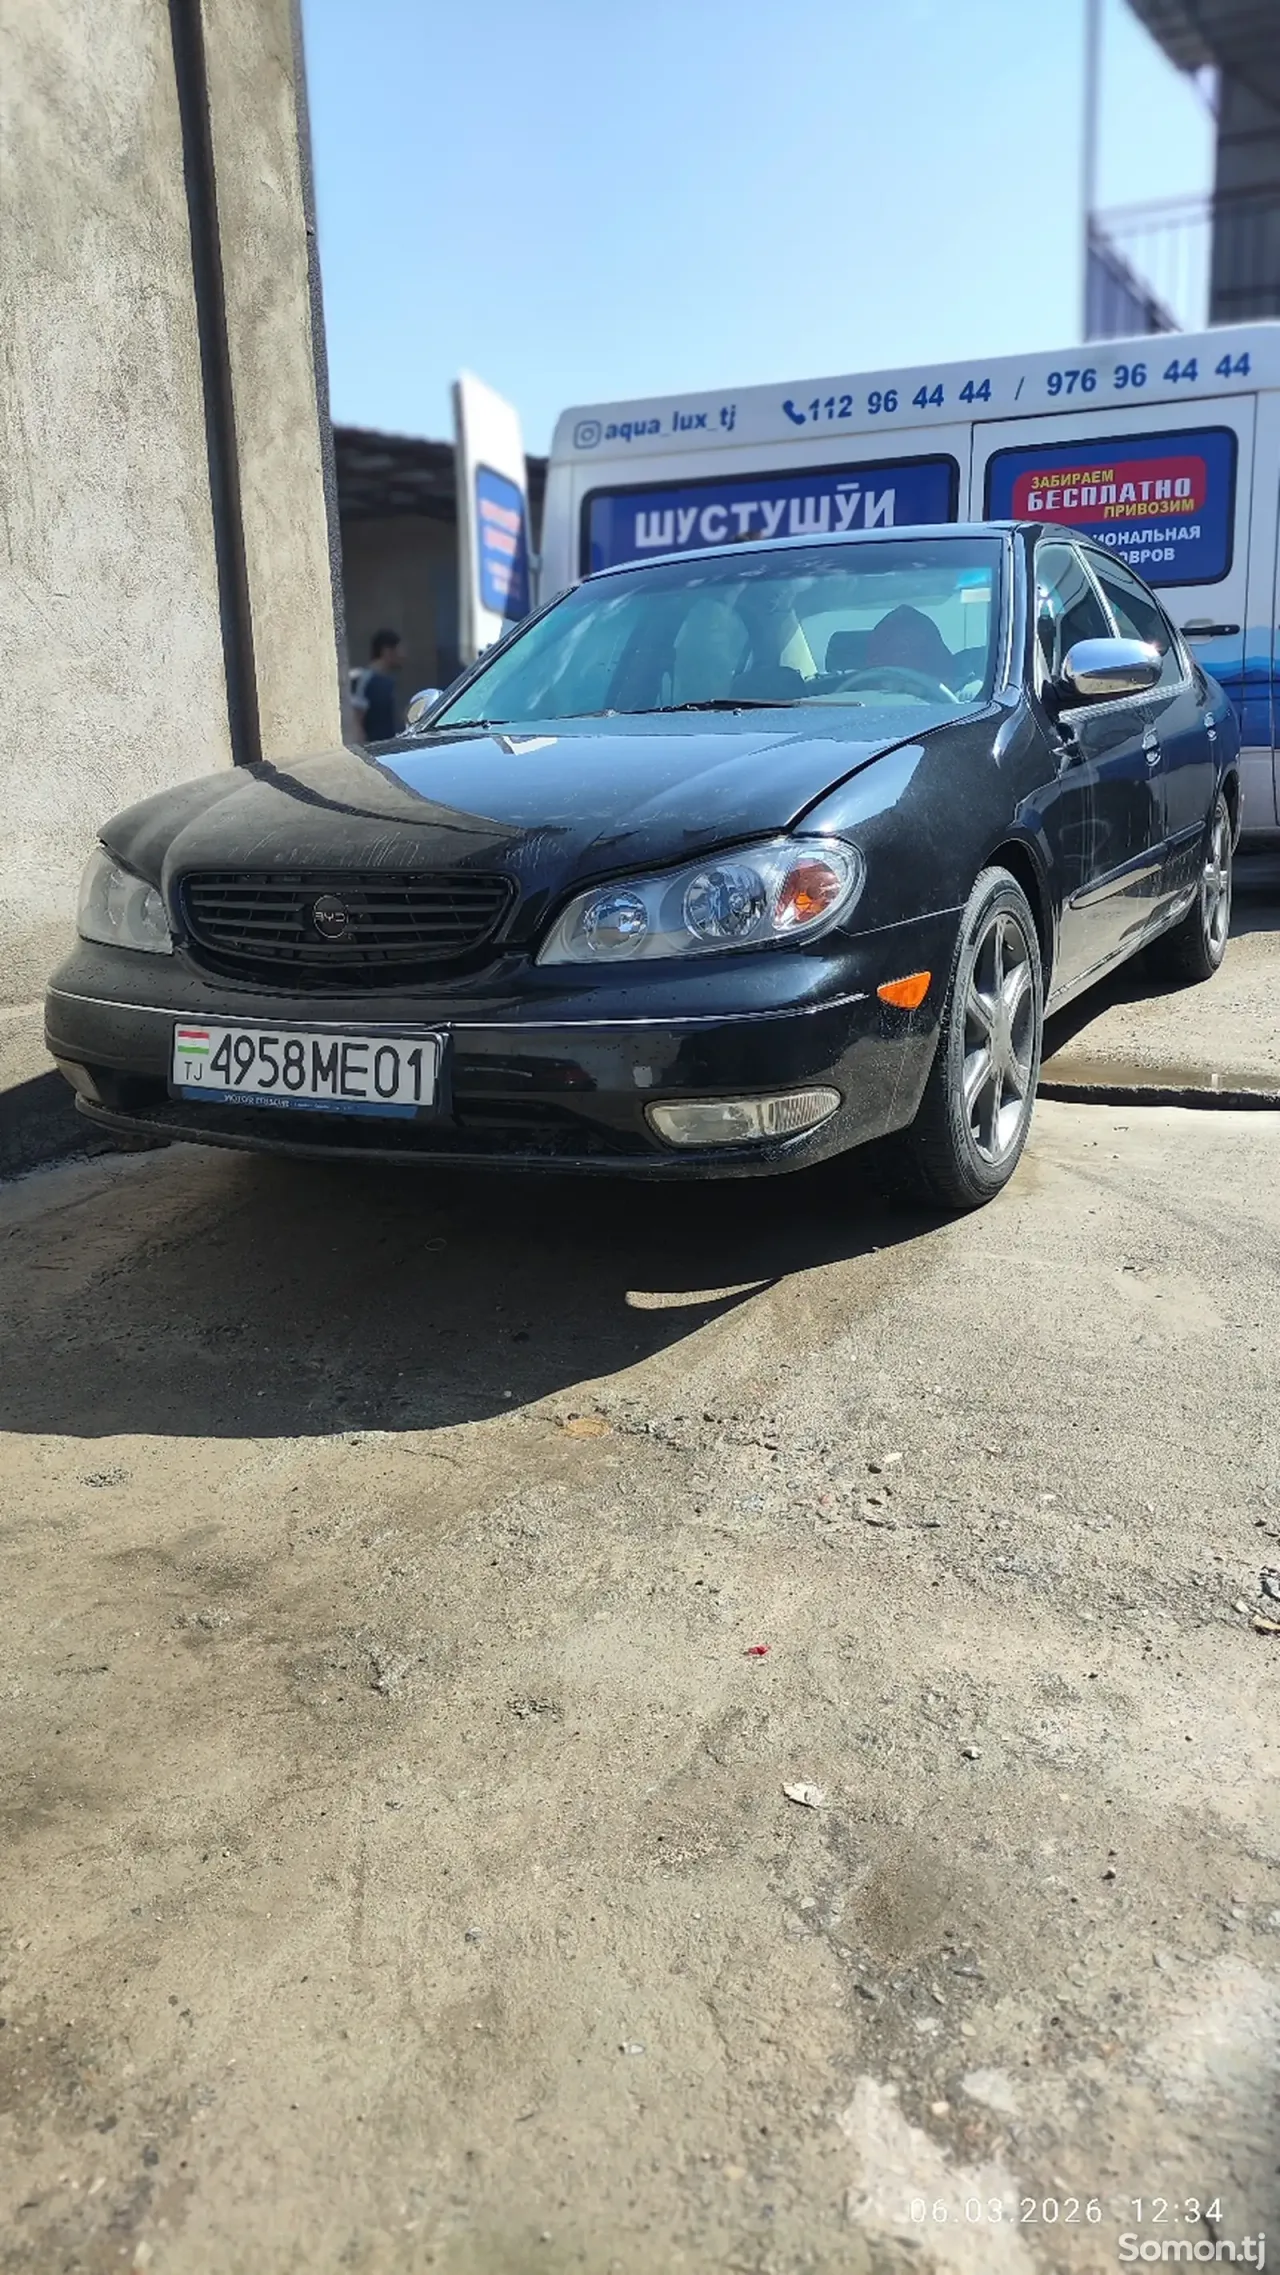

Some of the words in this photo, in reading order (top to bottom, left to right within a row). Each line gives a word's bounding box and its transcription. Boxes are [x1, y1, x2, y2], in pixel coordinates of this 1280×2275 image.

[808, 394, 853, 422] 112
[866, 389, 898, 415] 96
[912, 384, 945, 409] 44
[959, 379, 992, 404] 44
[1015, 377, 1026, 401] /
[1046, 368, 1097, 396] 976
[1113, 363, 1148, 389] 96
[1163, 358, 1198, 384] 44
[1215, 352, 1251, 378] 44
[603, 405, 737, 442] aqua_lux_tj
[1027, 477, 1192, 512] БЕСПЛАТНО
[1031, 469, 1114, 489] ЗАБИРАЕМ
[1103, 498, 1195, 519] ПРИВОЗИМ
[184, 1061, 204, 1081] TJ
[209, 1033, 423, 1101] 4958ME01
